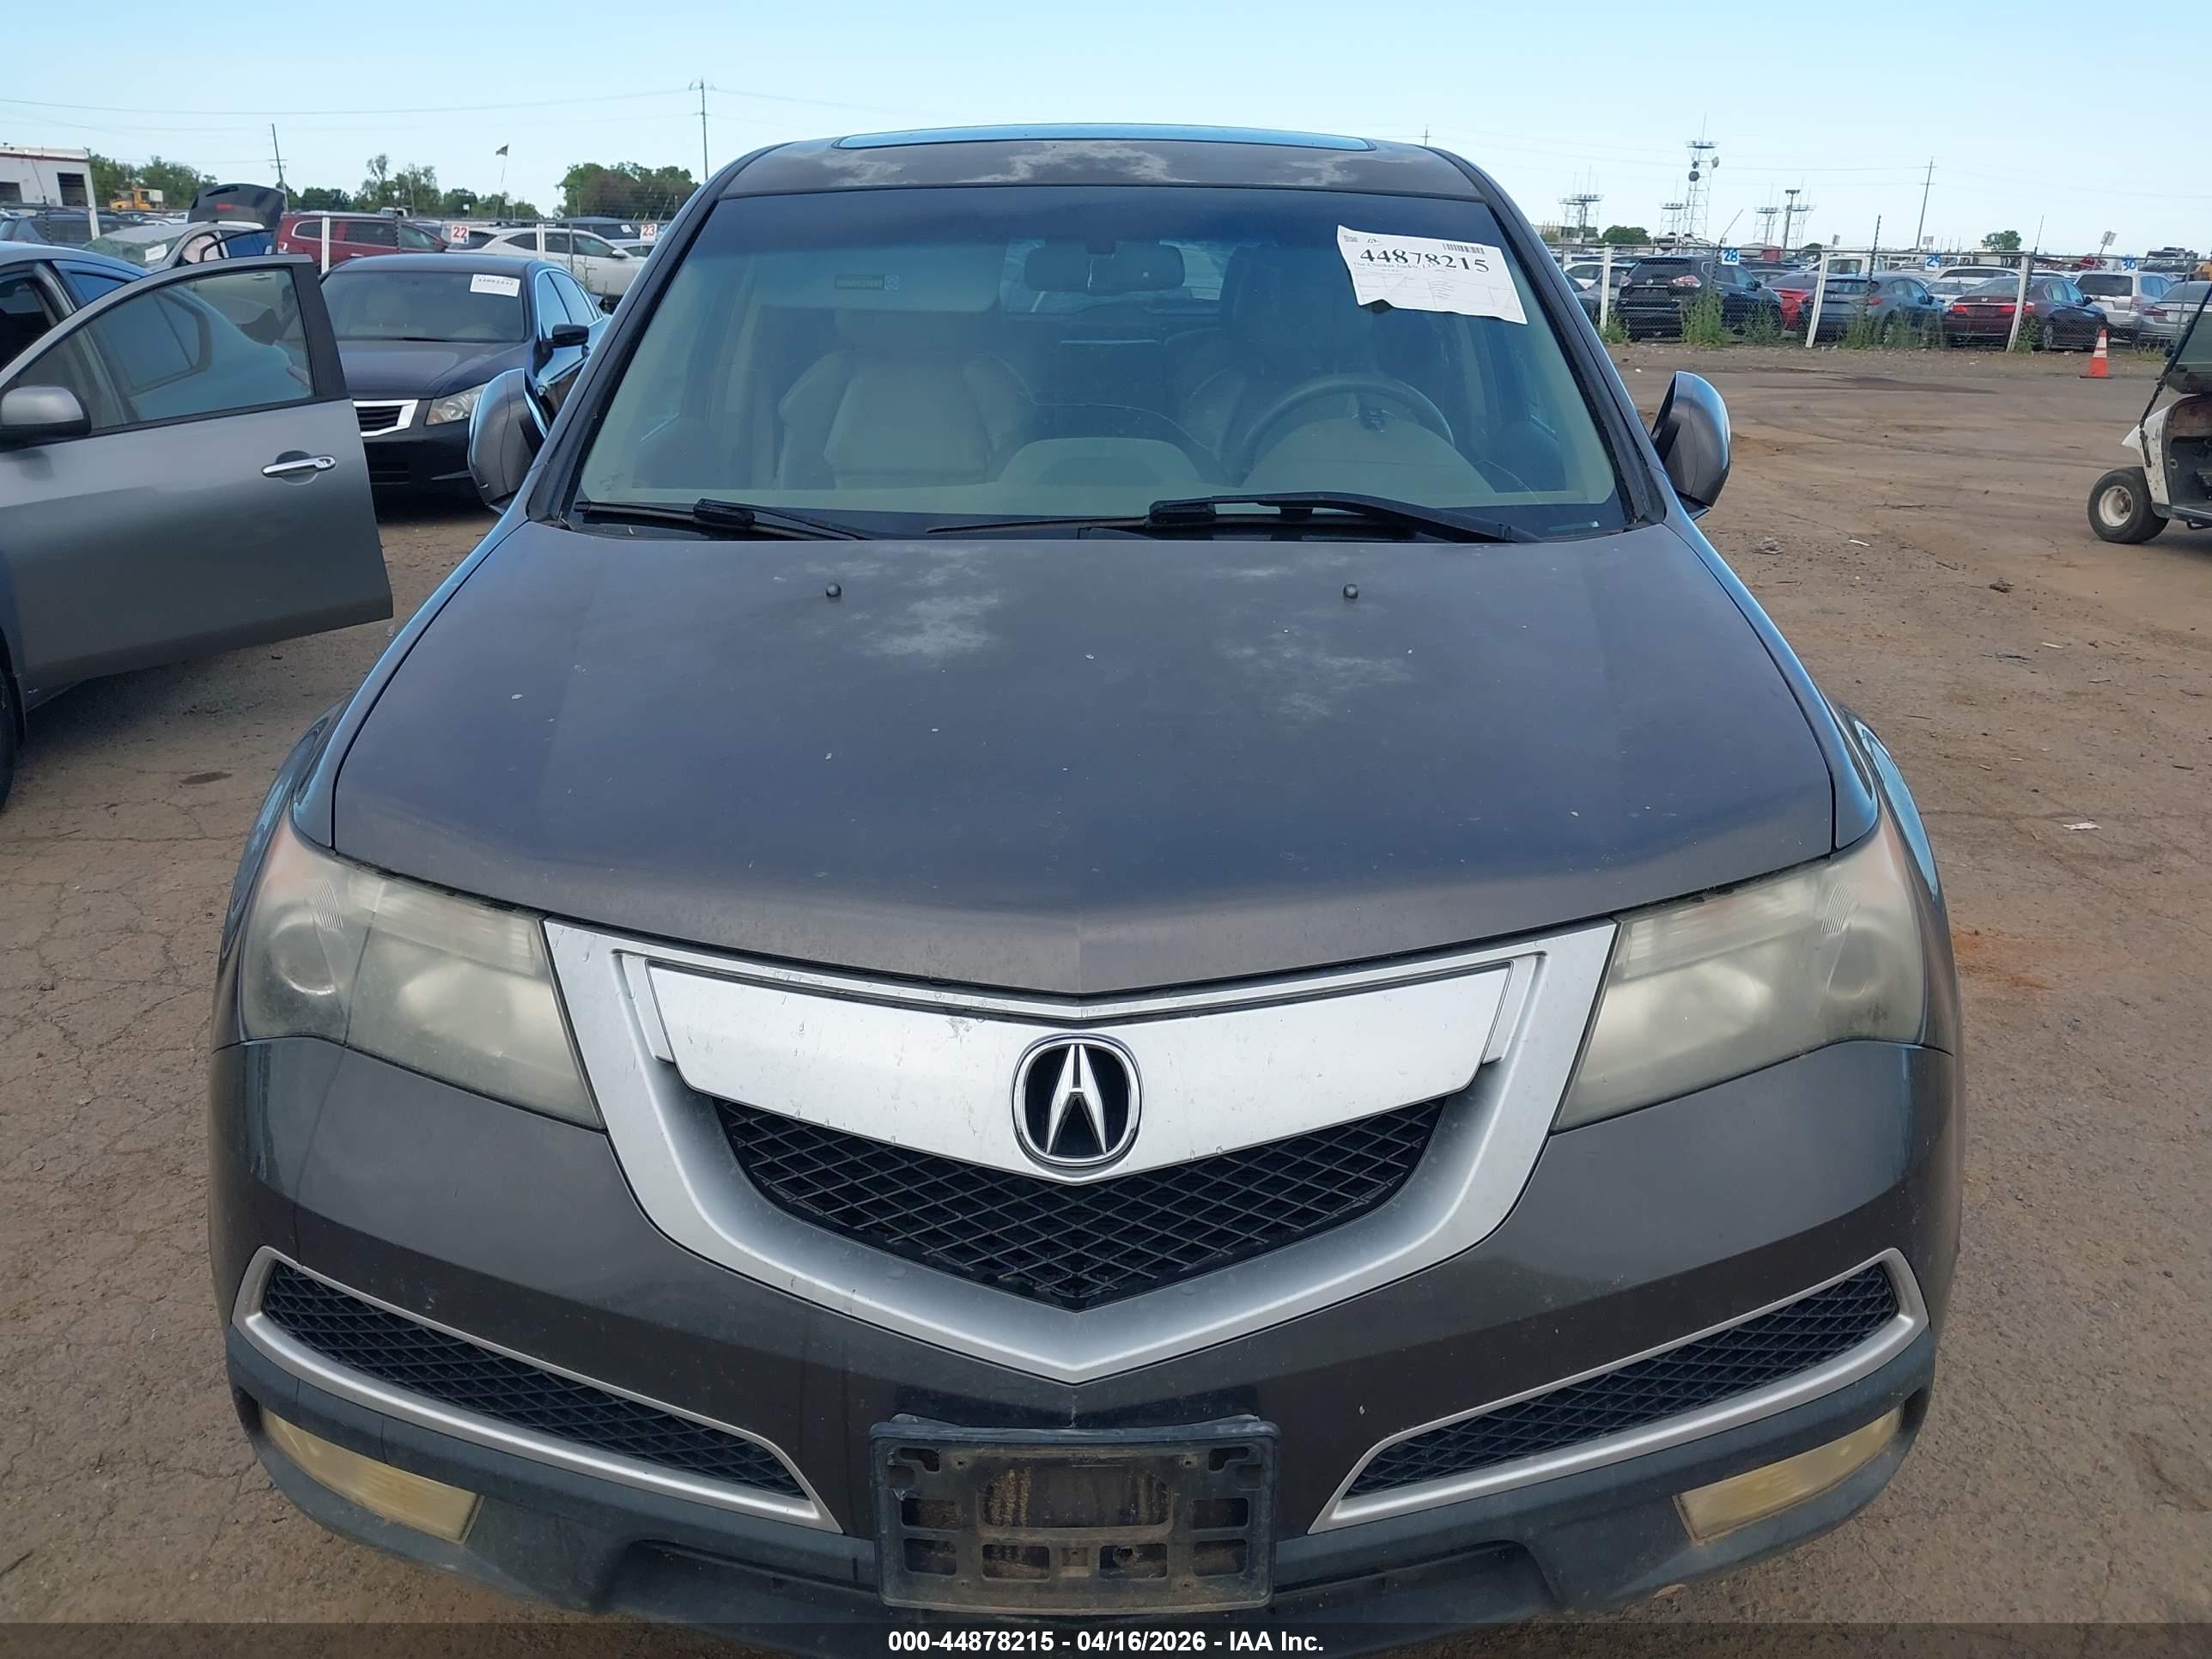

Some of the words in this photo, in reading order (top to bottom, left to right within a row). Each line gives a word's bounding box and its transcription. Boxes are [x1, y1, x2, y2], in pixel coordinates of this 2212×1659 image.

[453, 226, 468, 239] 22
[643, 225, 655, 236] 23
[1360, 248, 1490, 273] 44878215
[1723, 248, 1738, 262] 28
[1926, 255, 1942, 269] 29
[2123, 258, 2136, 270] 30
